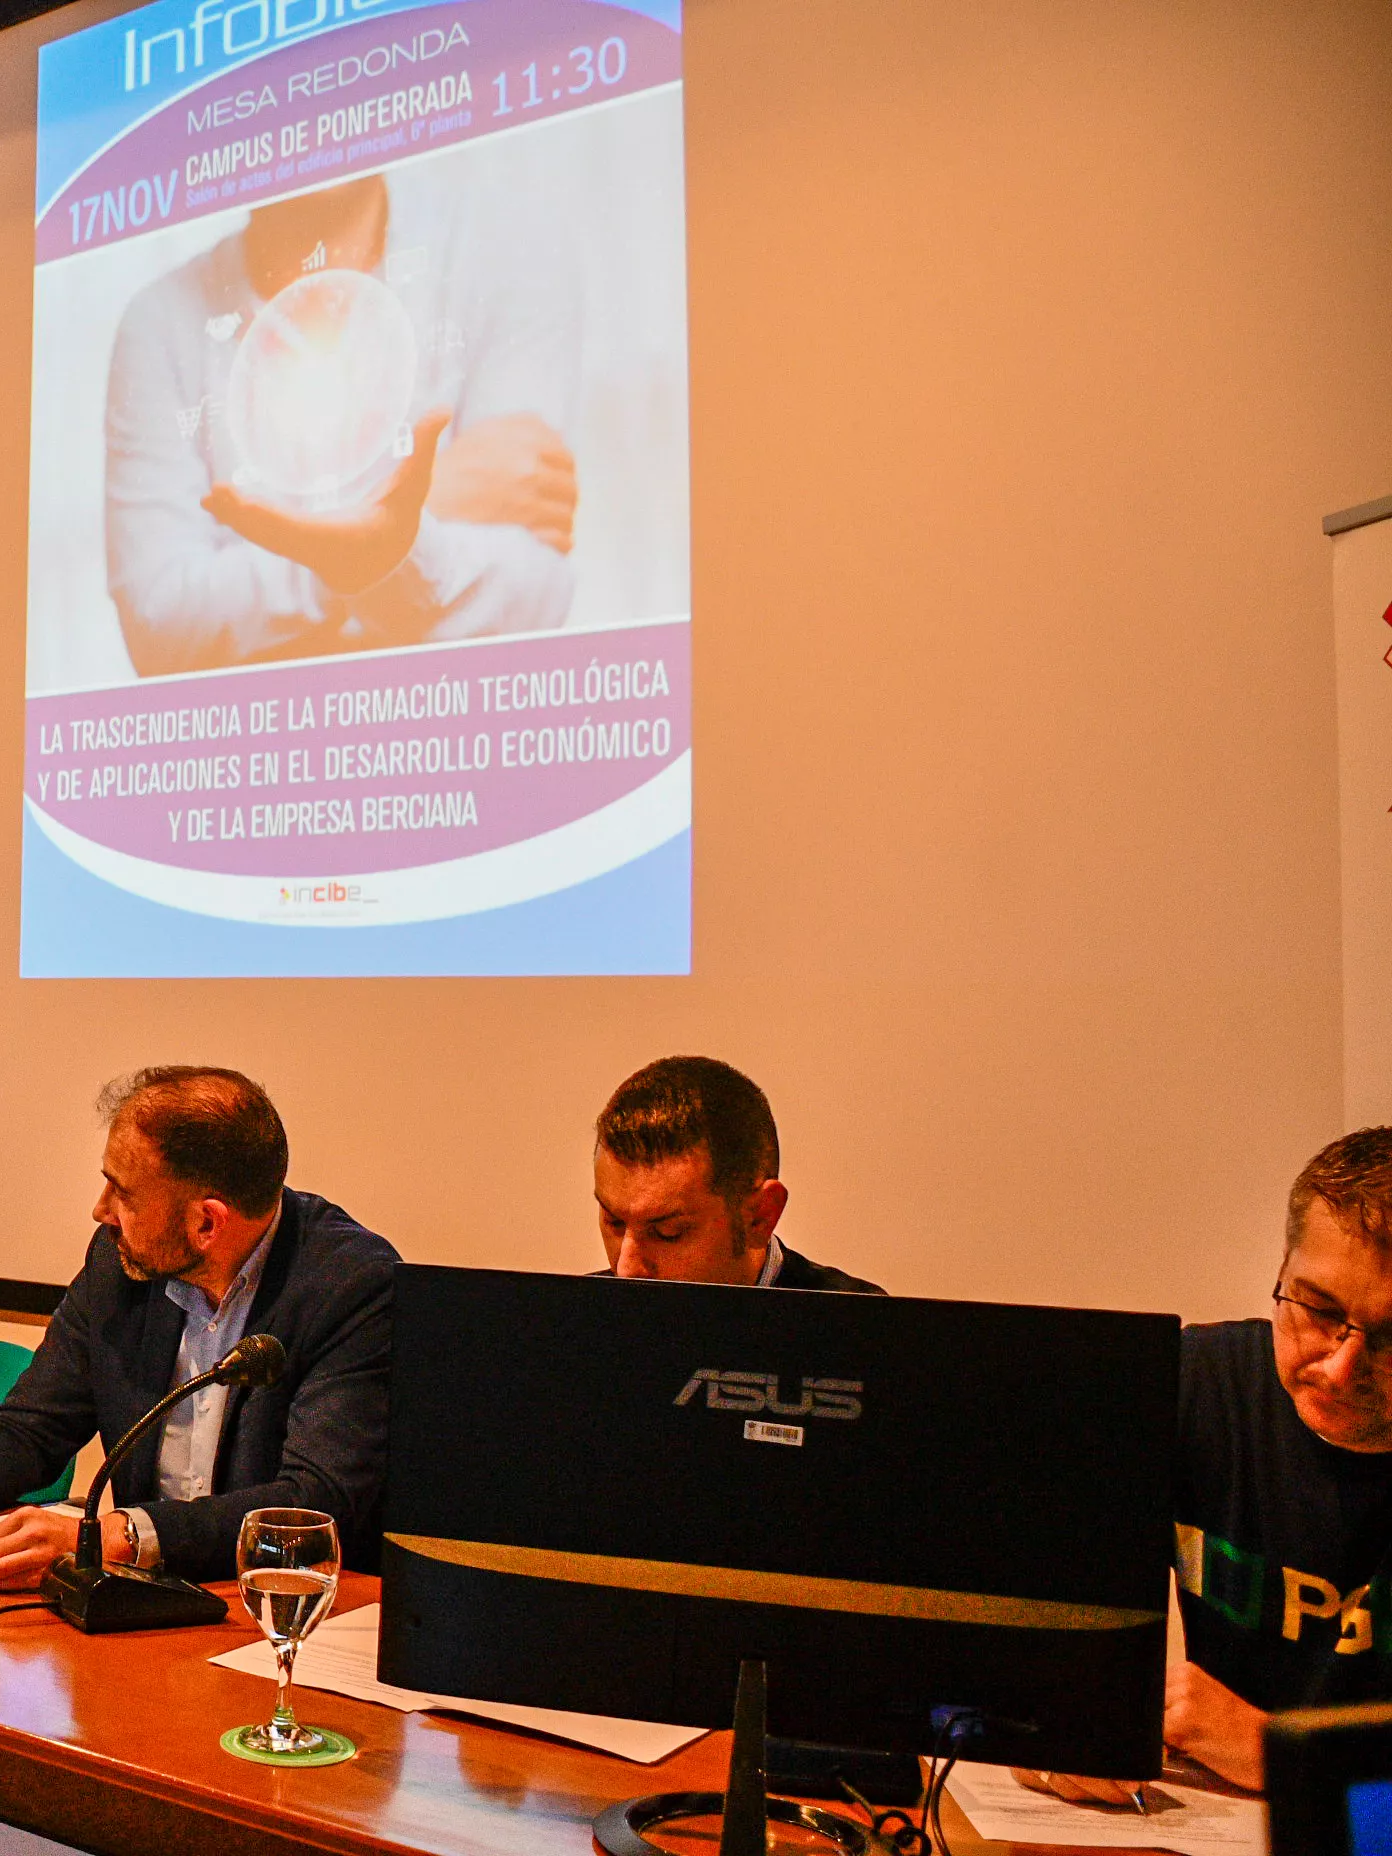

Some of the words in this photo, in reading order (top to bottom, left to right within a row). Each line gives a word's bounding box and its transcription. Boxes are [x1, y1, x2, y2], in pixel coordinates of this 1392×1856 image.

[187, 85, 278, 135] MESA
[288, 22, 470, 103] REDONDA
[491, 36, 627, 118] 11:30
[185, 131, 273, 187] CAMPUS
[280, 120, 309, 158] DE
[317, 71, 472, 147] PONFERRADA
[69, 168, 179, 245] 17NOV
[39, 722, 63, 755] LA
[70, 702, 242, 751] TRASCENDENCIA
[250, 699, 279, 734] DE
[287, 696, 315, 731] LA
[324, 675, 469, 728] FORMACIÓN
[479, 658, 670, 715] TECNOLÓGICA
[37, 773, 51, 803] Y
[57, 767, 83, 801] DE
[89, 754, 241, 798] APLICACIONES
[250, 752, 280, 786] EN
[288, 749, 316, 784] EL
[324, 735, 490, 781] DESARROLLO
[501, 716, 672, 768] ECONÓMICO
[168, 811, 182, 844] Y
[187, 809, 215, 842] DE
[220, 806, 246, 839] LA
[251, 799, 356, 838] EMPRESA
[362, 790, 478, 832] BERCIANA
[672, 1368, 864, 1420] ASUS
